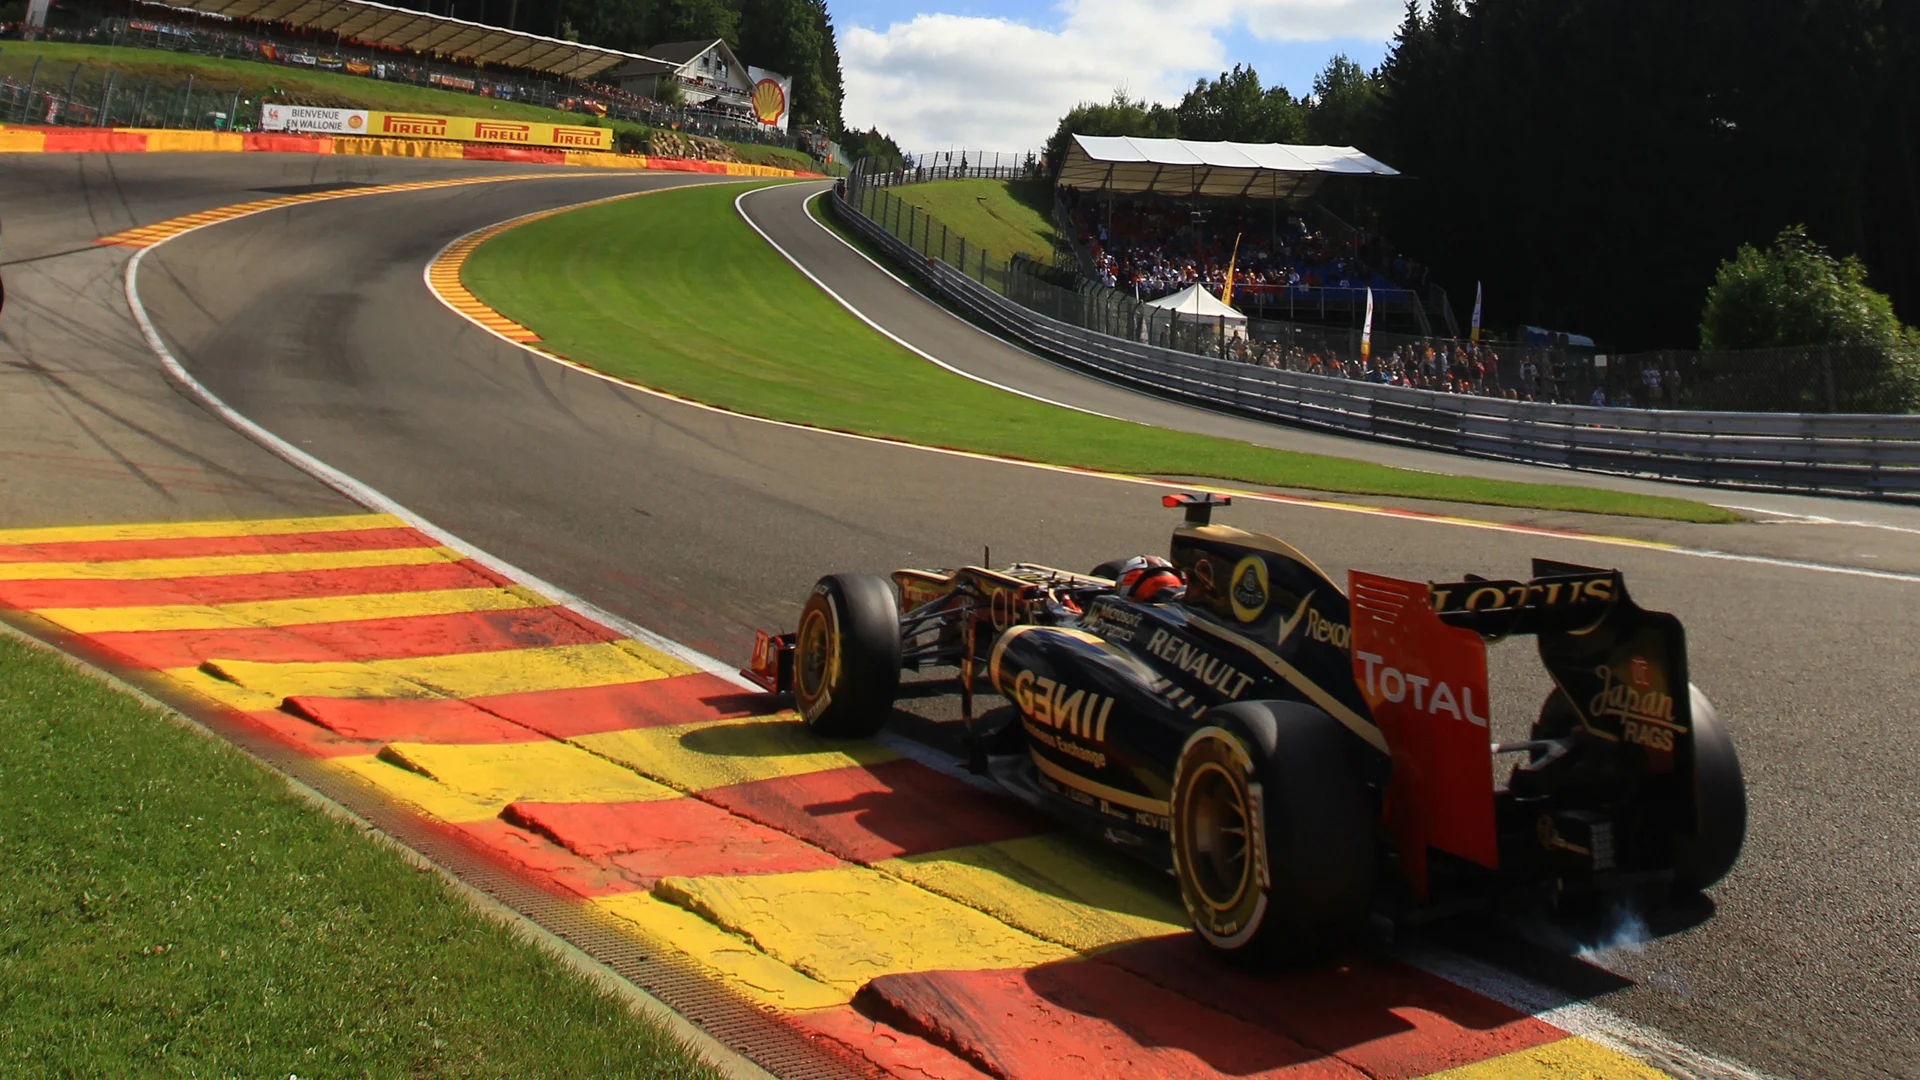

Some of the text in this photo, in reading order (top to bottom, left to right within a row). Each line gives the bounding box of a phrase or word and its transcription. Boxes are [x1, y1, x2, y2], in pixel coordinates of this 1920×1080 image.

[286, 119, 299, 129] EN
[300, 120, 342, 130] WALLONIE
[291, 108, 340, 120] BIENVENUE
[383, 115, 447, 136] PIRELLI
[475, 122, 530, 141] PIRELLI
[553, 128, 601, 146] PIRELLI
[1431, 578, 1613, 612] LOTUS
[1146, 627, 1255, 699] RENAULT
[1356, 650, 1487, 728] TOTAL
[1590, 665, 1676, 724] Japan
[1624, 721, 1674, 752] RAGS
[1056, 736, 1106, 769] Exchange
